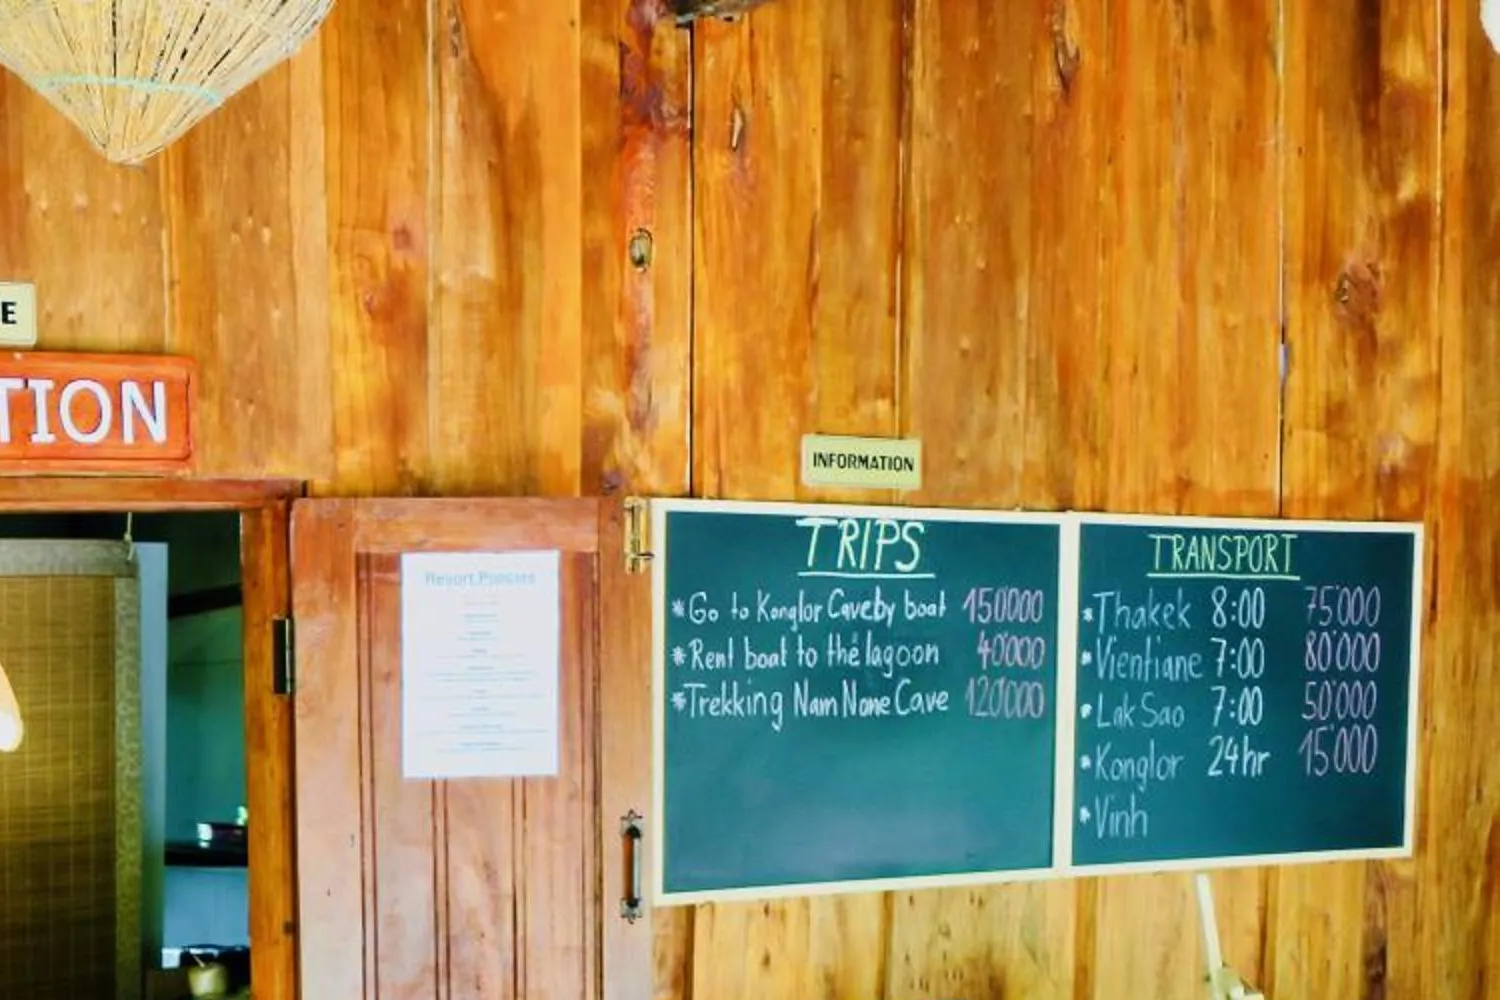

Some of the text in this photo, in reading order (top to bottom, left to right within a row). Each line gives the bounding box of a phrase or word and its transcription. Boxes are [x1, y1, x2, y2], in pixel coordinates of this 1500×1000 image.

[813, 451, 916, 473] INFORMATION
[796, 518, 926, 573] TRIPS
[1148, 534, 1299, 573] TRANSPORT
[689, 590, 720, 625] Go
[731, 591, 750, 620] to
[756, 588, 824, 632] Konglor
[904, 588, 947, 620] boat
[1092, 587, 1192, 635] Thakek
[1210, 586, 1266, 630] 8:00
[688, 636, 734, 671] Rent
[744, 634, 788, 671] boat
[797, 633, 818, 669] to
[827, 631, 861, 667] the
[864, 629, 940, 679] lagoon
[1095, 635, 1205, 682] Vientiane
[1210, 637, 1266, 680] 7:00
[683, 678, 784, 733] Trekking
[793, 676, 839, 718] Nam
[895, 677, 950, 716] Cave
[1095, 692, 1134, 729] Lak
[1140, 691, 1185, 729] Sao
[1210, 684, 1265, 728] 7:00
[1094, 739, 1185, 793] Konglor
[1093, 792, 1149, 839] Vinh
